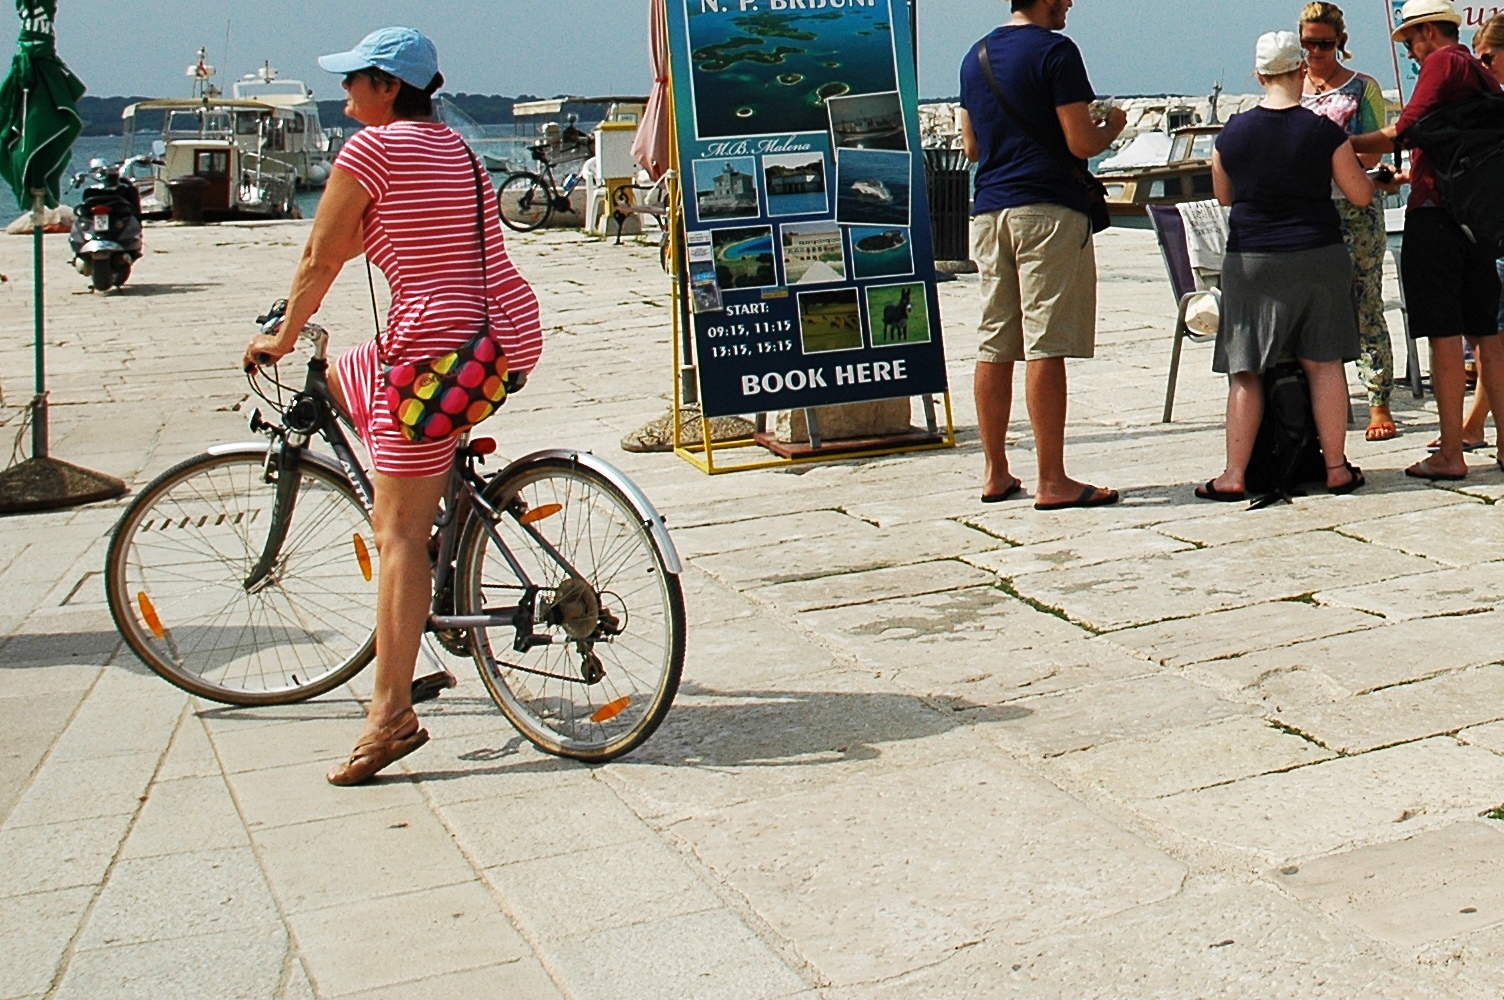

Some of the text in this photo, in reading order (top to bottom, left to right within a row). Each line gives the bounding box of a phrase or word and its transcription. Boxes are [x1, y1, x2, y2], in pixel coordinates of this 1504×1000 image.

[726, 302, 769, 317] START:
[707, 320, 791, 338] 09:15, 11:15
[757, 340, 792, 354] 15:15
[741, 359, 908, 396] BOOK HERE
